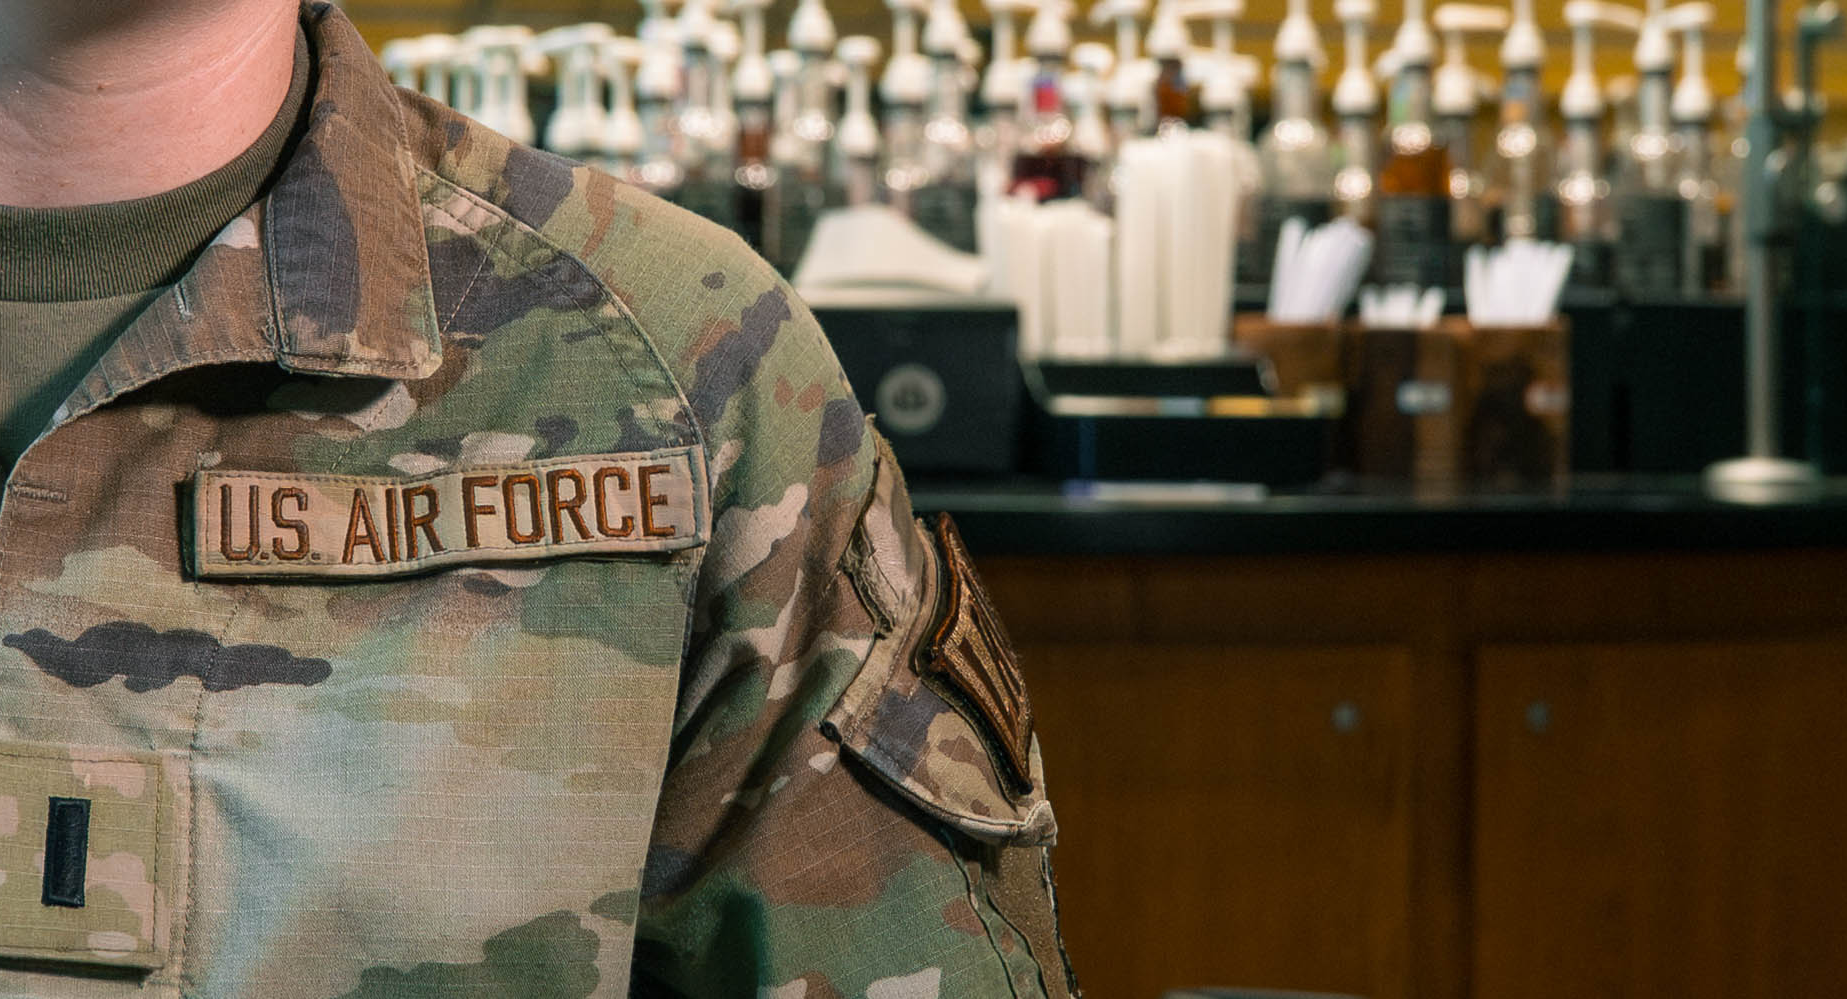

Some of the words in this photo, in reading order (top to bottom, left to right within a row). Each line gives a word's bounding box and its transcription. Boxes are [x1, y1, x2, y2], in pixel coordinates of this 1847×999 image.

[220, 483, 321, 561] U.S.
[341, 483, 448, 564] AIR
[460, 465, 677, 548] FORCE
